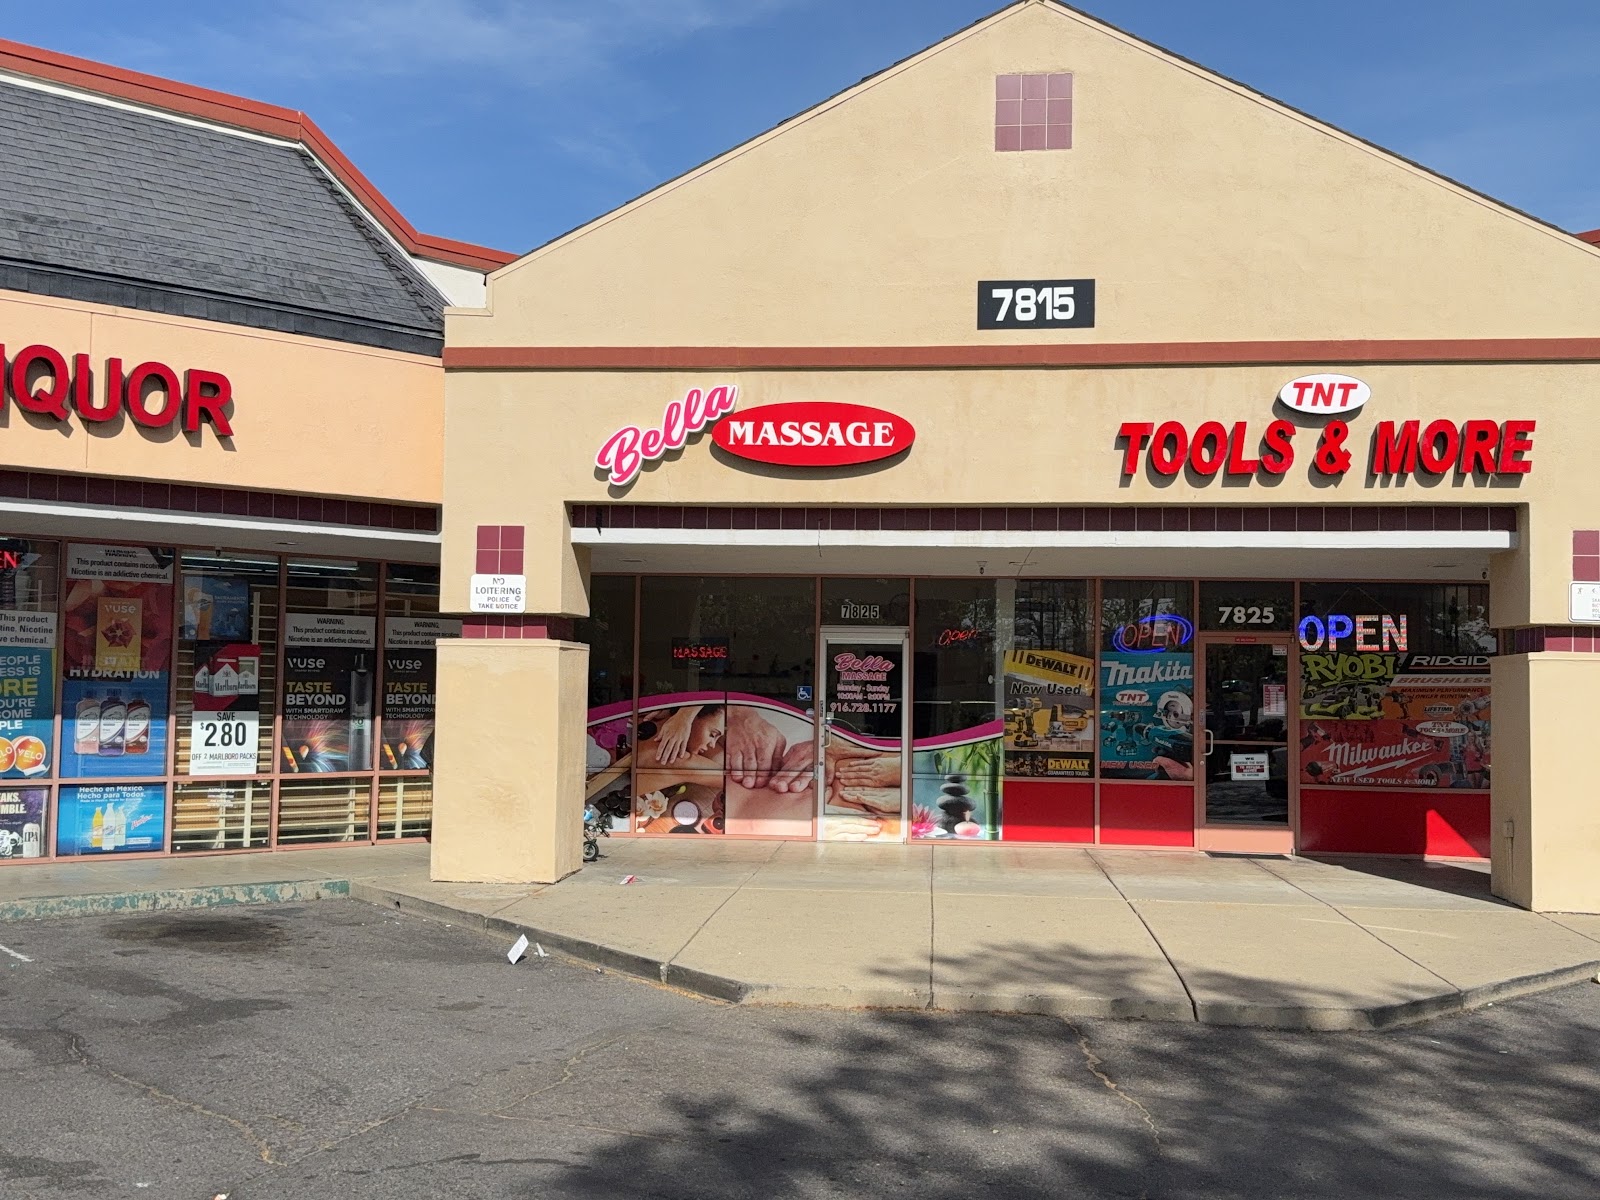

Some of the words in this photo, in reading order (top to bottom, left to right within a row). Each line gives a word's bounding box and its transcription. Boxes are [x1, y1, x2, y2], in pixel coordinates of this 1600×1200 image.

[992, 287, 1075, 321] 7815
[1292, 382, 1359, 407] TNT
[595, 384, 739, 486] Bella
[728, 421, 895, 447] MASSAGE
[1118, 419, 1296, 476] TOOLS
[1314, 419, 1352, 475] &
[1373, 419, 1537, 475] MORE
[76, 557, 89, 565] This
[90, 559, 113, 567] product
[71, 568, 97, 576] Nicotine
[113, 570, 140, 578] addictive
[492, 577, 505, 585] NO
[475, 587, 521, 595] LOITERING
[842, 605, 879, 618] 7825
[1218, 606, 1275, 624] 7825
[18, 615, 49, 623] product
[19, 625, 53, 634] Nicotine
[1122, 623, 1180, 647] OPEN
[1299, 614, 1408, 652] OPEN
[10, 635, 49, 644] chemical.
[673, 646, 728, 658] MASSAGE
[834, 652, 895, 672] Bella
[1410, 655, 1490, 666] RIDGID
[28, 666, 41, 676] IS
[69, 666, 160, 679] HYDRATION
[1101, 660, 1194, 686] Makita
[1301, 653, 1396, 681] RYOBI
[841, 671, 887, 681] MASSAGE
[0, 677, 38, 697] RE
[286, 681, 332, 693] TASTE
[386, 682, 428, 693] TASTE
[1011, 682, 1042, 695] New
[1047, 684, 1082, 695] Used
[286, 693, 347, 705] BEYOND
[1119, 693, 1147, 702] TNT
[830, 702, 897, 713] 916.728.1177
[0, 709, 32, 719] OME
[217, 711, 236, 721] SAVE
[200, 722, 247, 747] $2.80
[18, 747, 43, 760] VELO
[239, 752, 257, 760] PACKS
[1321, 737, 1433, 766] Milwaukee
[0, 792, 21, 802] AKS.
[25, 831, 38, 842] IPA
